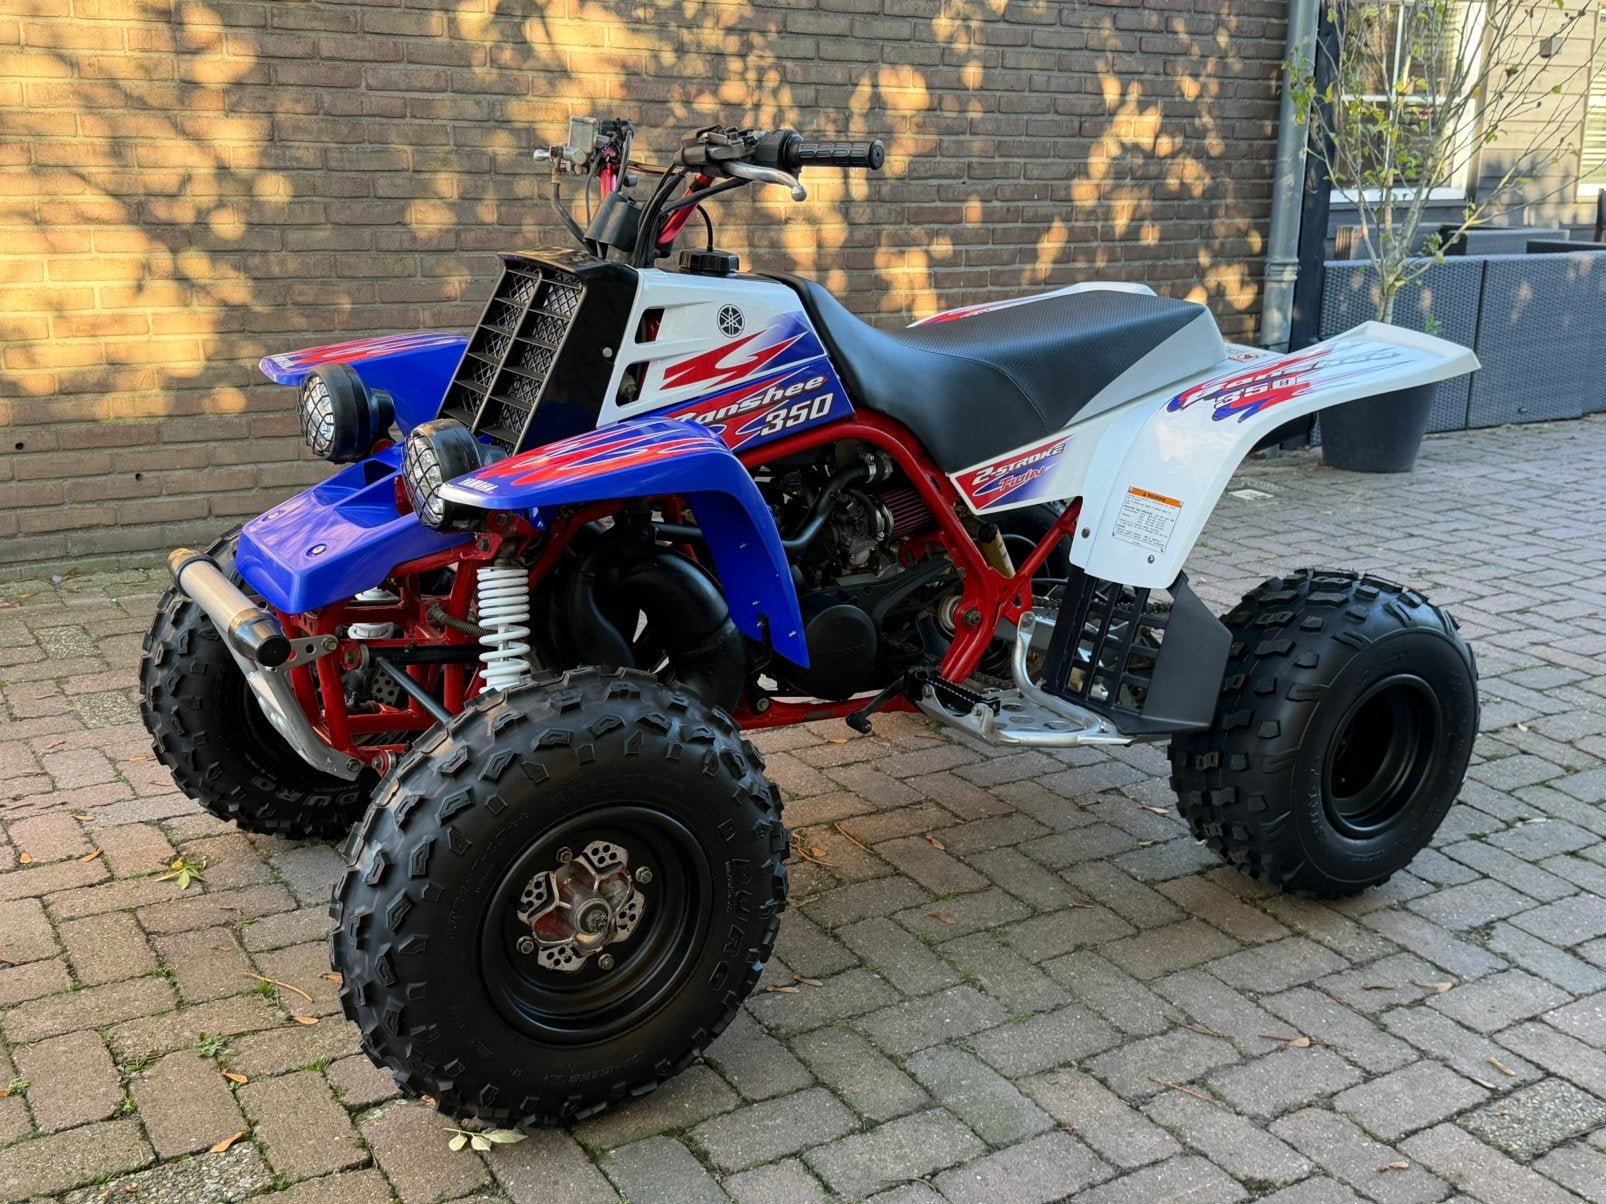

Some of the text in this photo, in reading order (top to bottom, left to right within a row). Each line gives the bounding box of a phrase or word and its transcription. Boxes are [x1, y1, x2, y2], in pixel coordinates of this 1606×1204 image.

[760, 393, 834, 437] 350
[972, 443, 1066, 486] 2-STROKE
[708, 858, 753, 992] DURO
